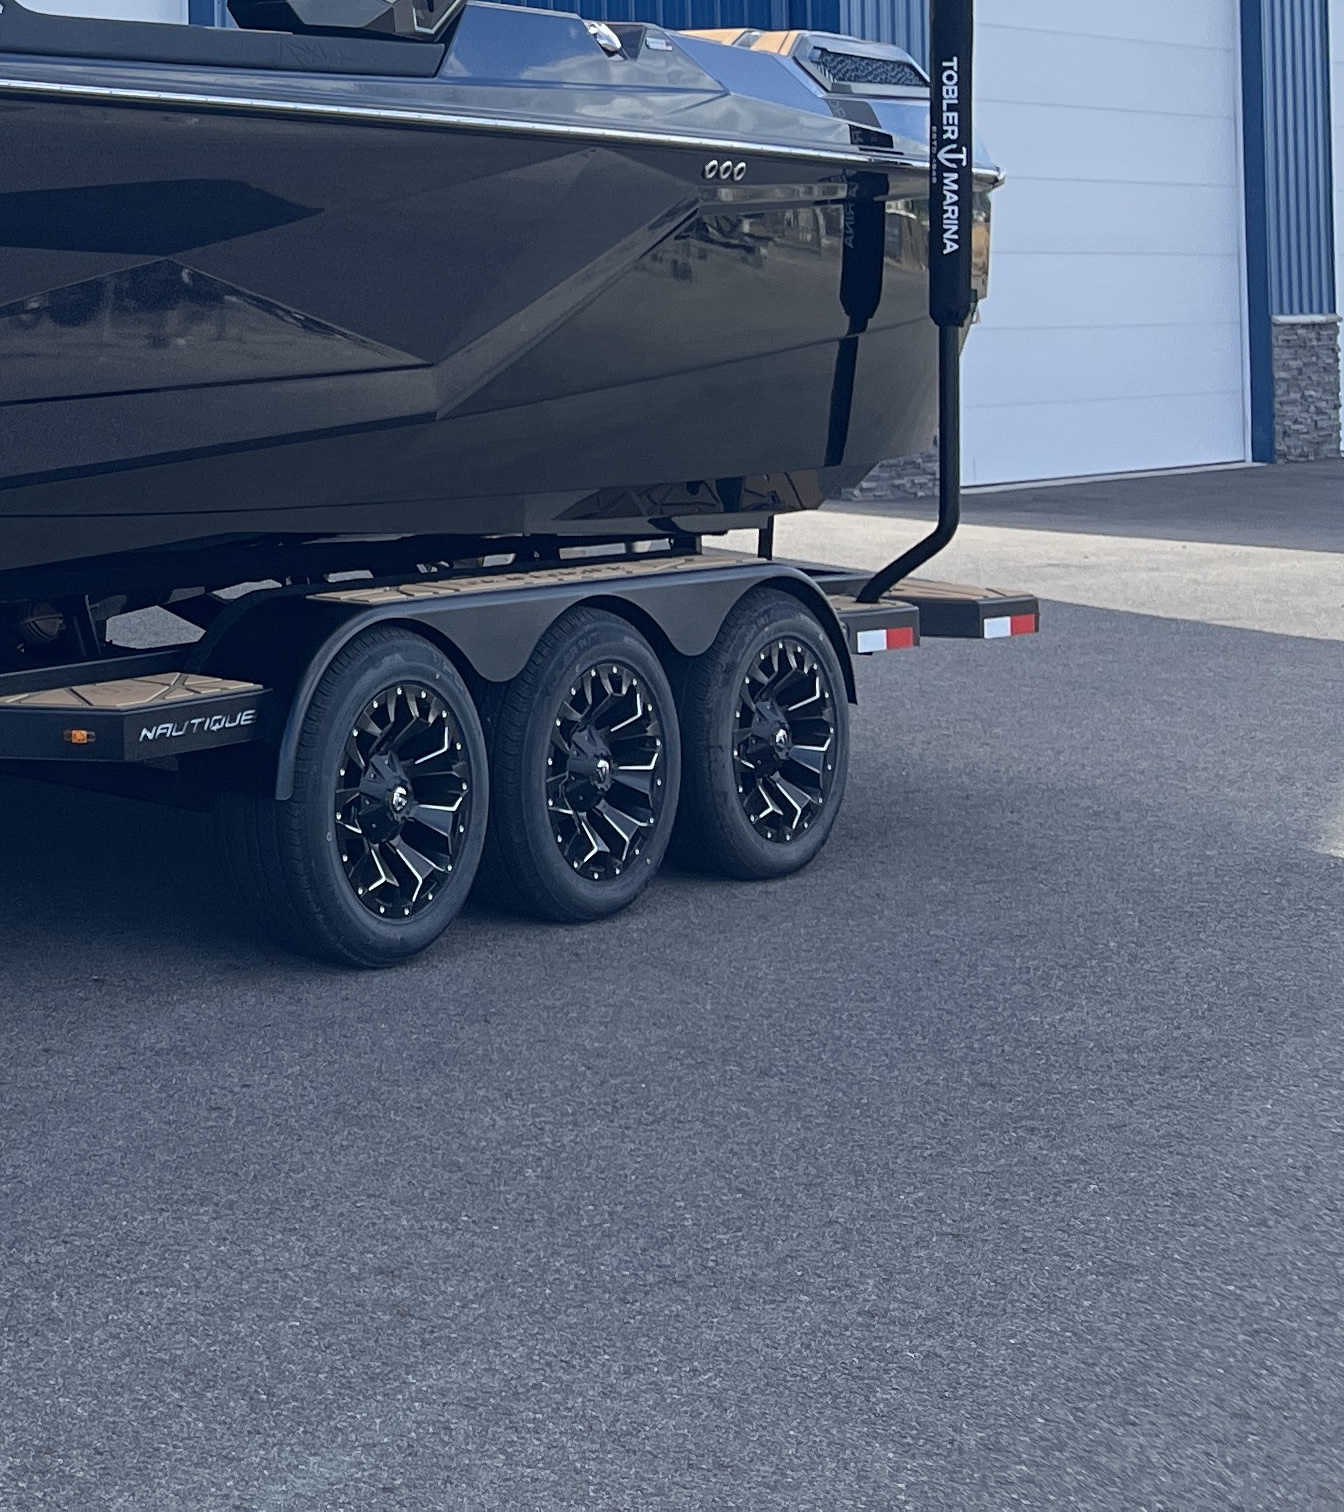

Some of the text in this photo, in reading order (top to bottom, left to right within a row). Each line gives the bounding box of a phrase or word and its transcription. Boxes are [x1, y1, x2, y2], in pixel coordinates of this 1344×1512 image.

[941, 56, 959, 255] TOBLER MARINA
[138, 709, 257, 742] NAUTIQUE
